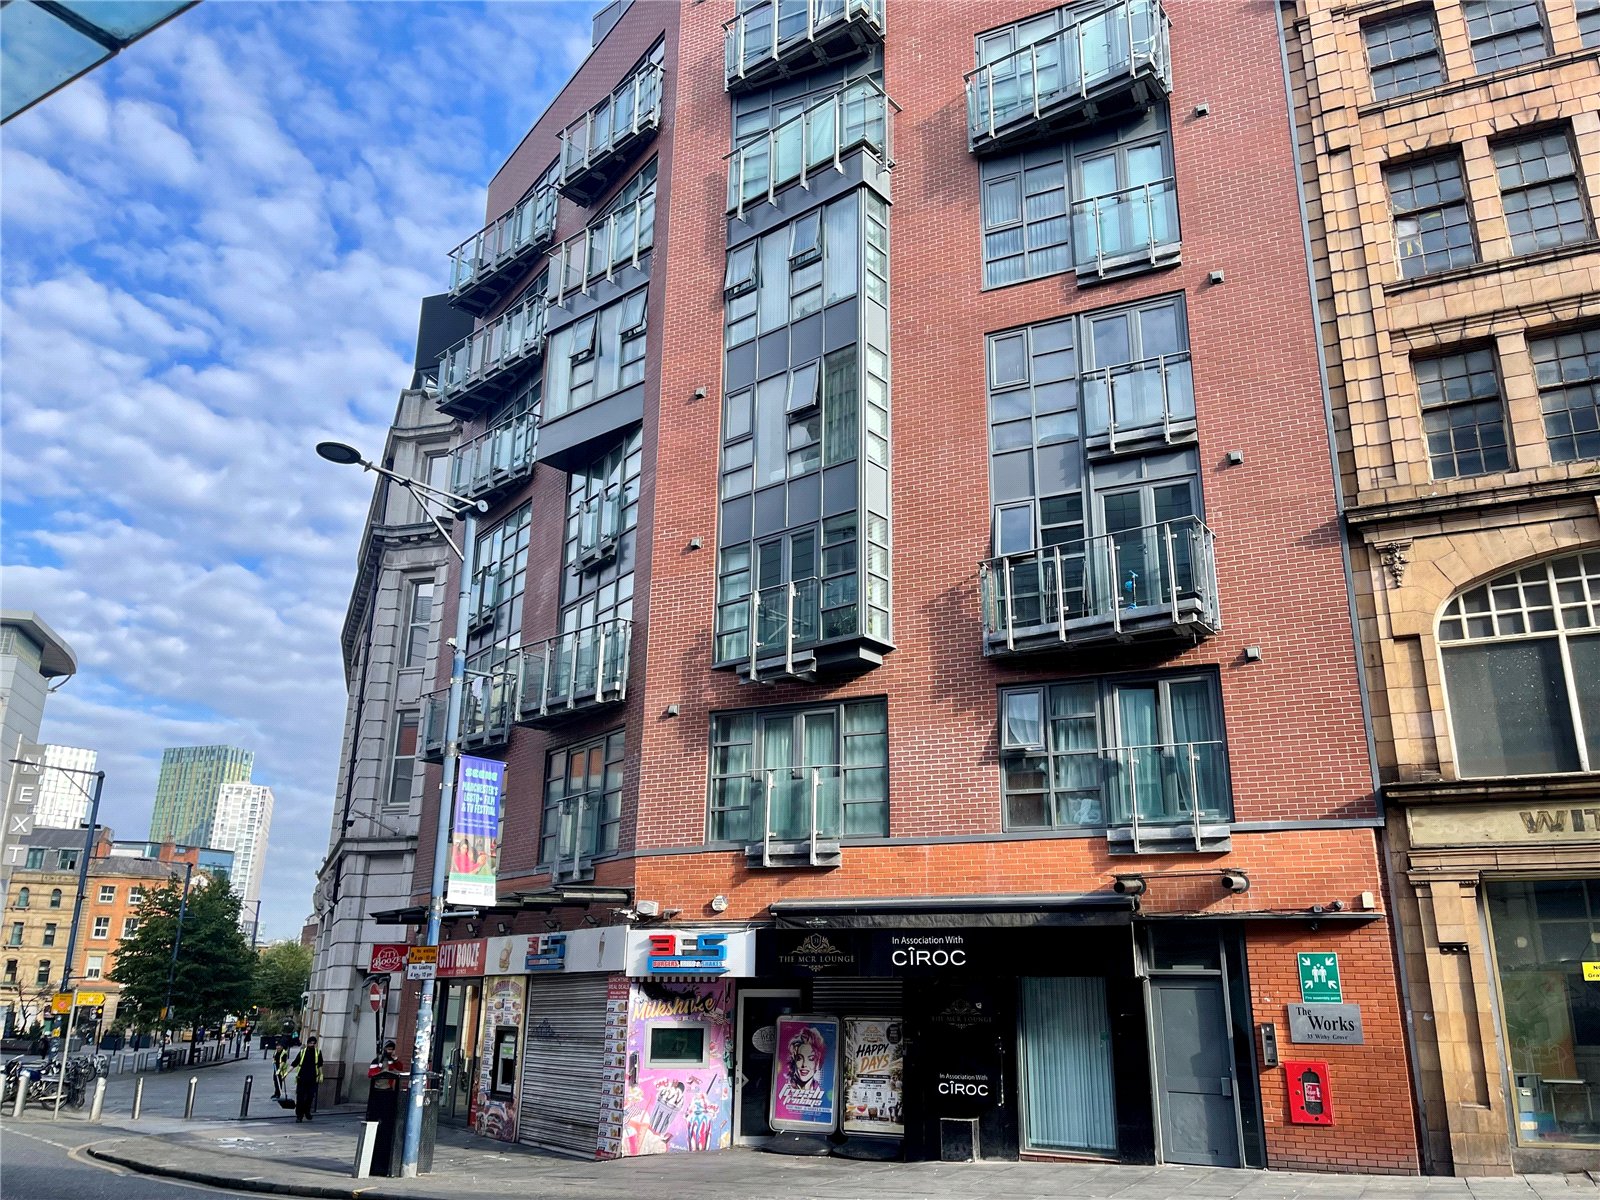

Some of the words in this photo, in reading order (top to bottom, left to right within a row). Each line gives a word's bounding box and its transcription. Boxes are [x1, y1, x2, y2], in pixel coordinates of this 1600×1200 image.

[484, 795, 496, 806] FILM
[7, 755, 41, 864] NEXT
[467, 803, 474, 813] TV
[474, 804, 496, 816] FESTIVAL
[892, 936, 899, 944] In
[900, 936, 944, 944] Association
[945, 935, 964, 944] With
[439, 944, 457, 968] CITY
[456, 942, 481, 967] BOOZE
[778, 955, 795, 963] THE
[798, 955, 817, 963] MCR
[820, 955, 855, 963] LOUNGE
[892, 947, 966, 966] CÎROC
[1296, 1007, 1312, 1016] The
[1307, 1015, 1355, 1031] Works
[856, 1043, 890, 1058] HAPPY
[860, 1054, 890, 1073] DAYS
[938, 1080, 989, 1096] CÎROC
